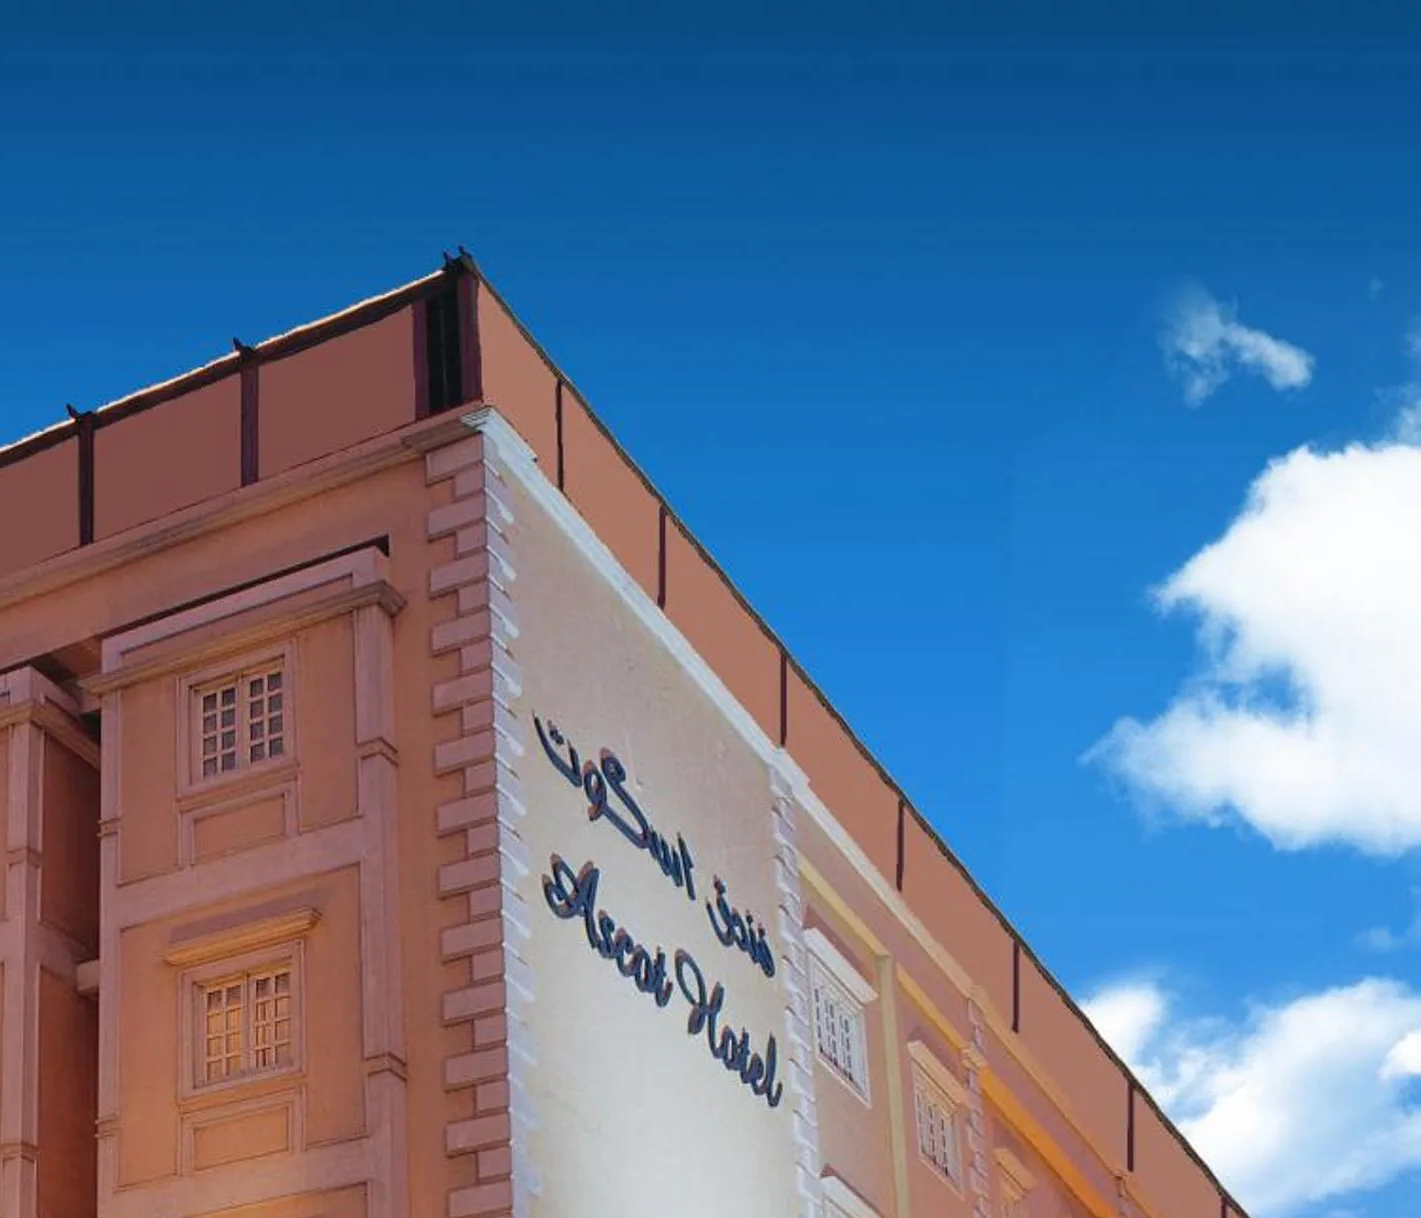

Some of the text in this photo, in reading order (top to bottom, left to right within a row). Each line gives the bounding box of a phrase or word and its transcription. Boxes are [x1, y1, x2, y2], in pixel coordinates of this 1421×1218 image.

[542, 853, 783, 1107] Ascot Hotel
[705, 874, 776, 978] فندق
